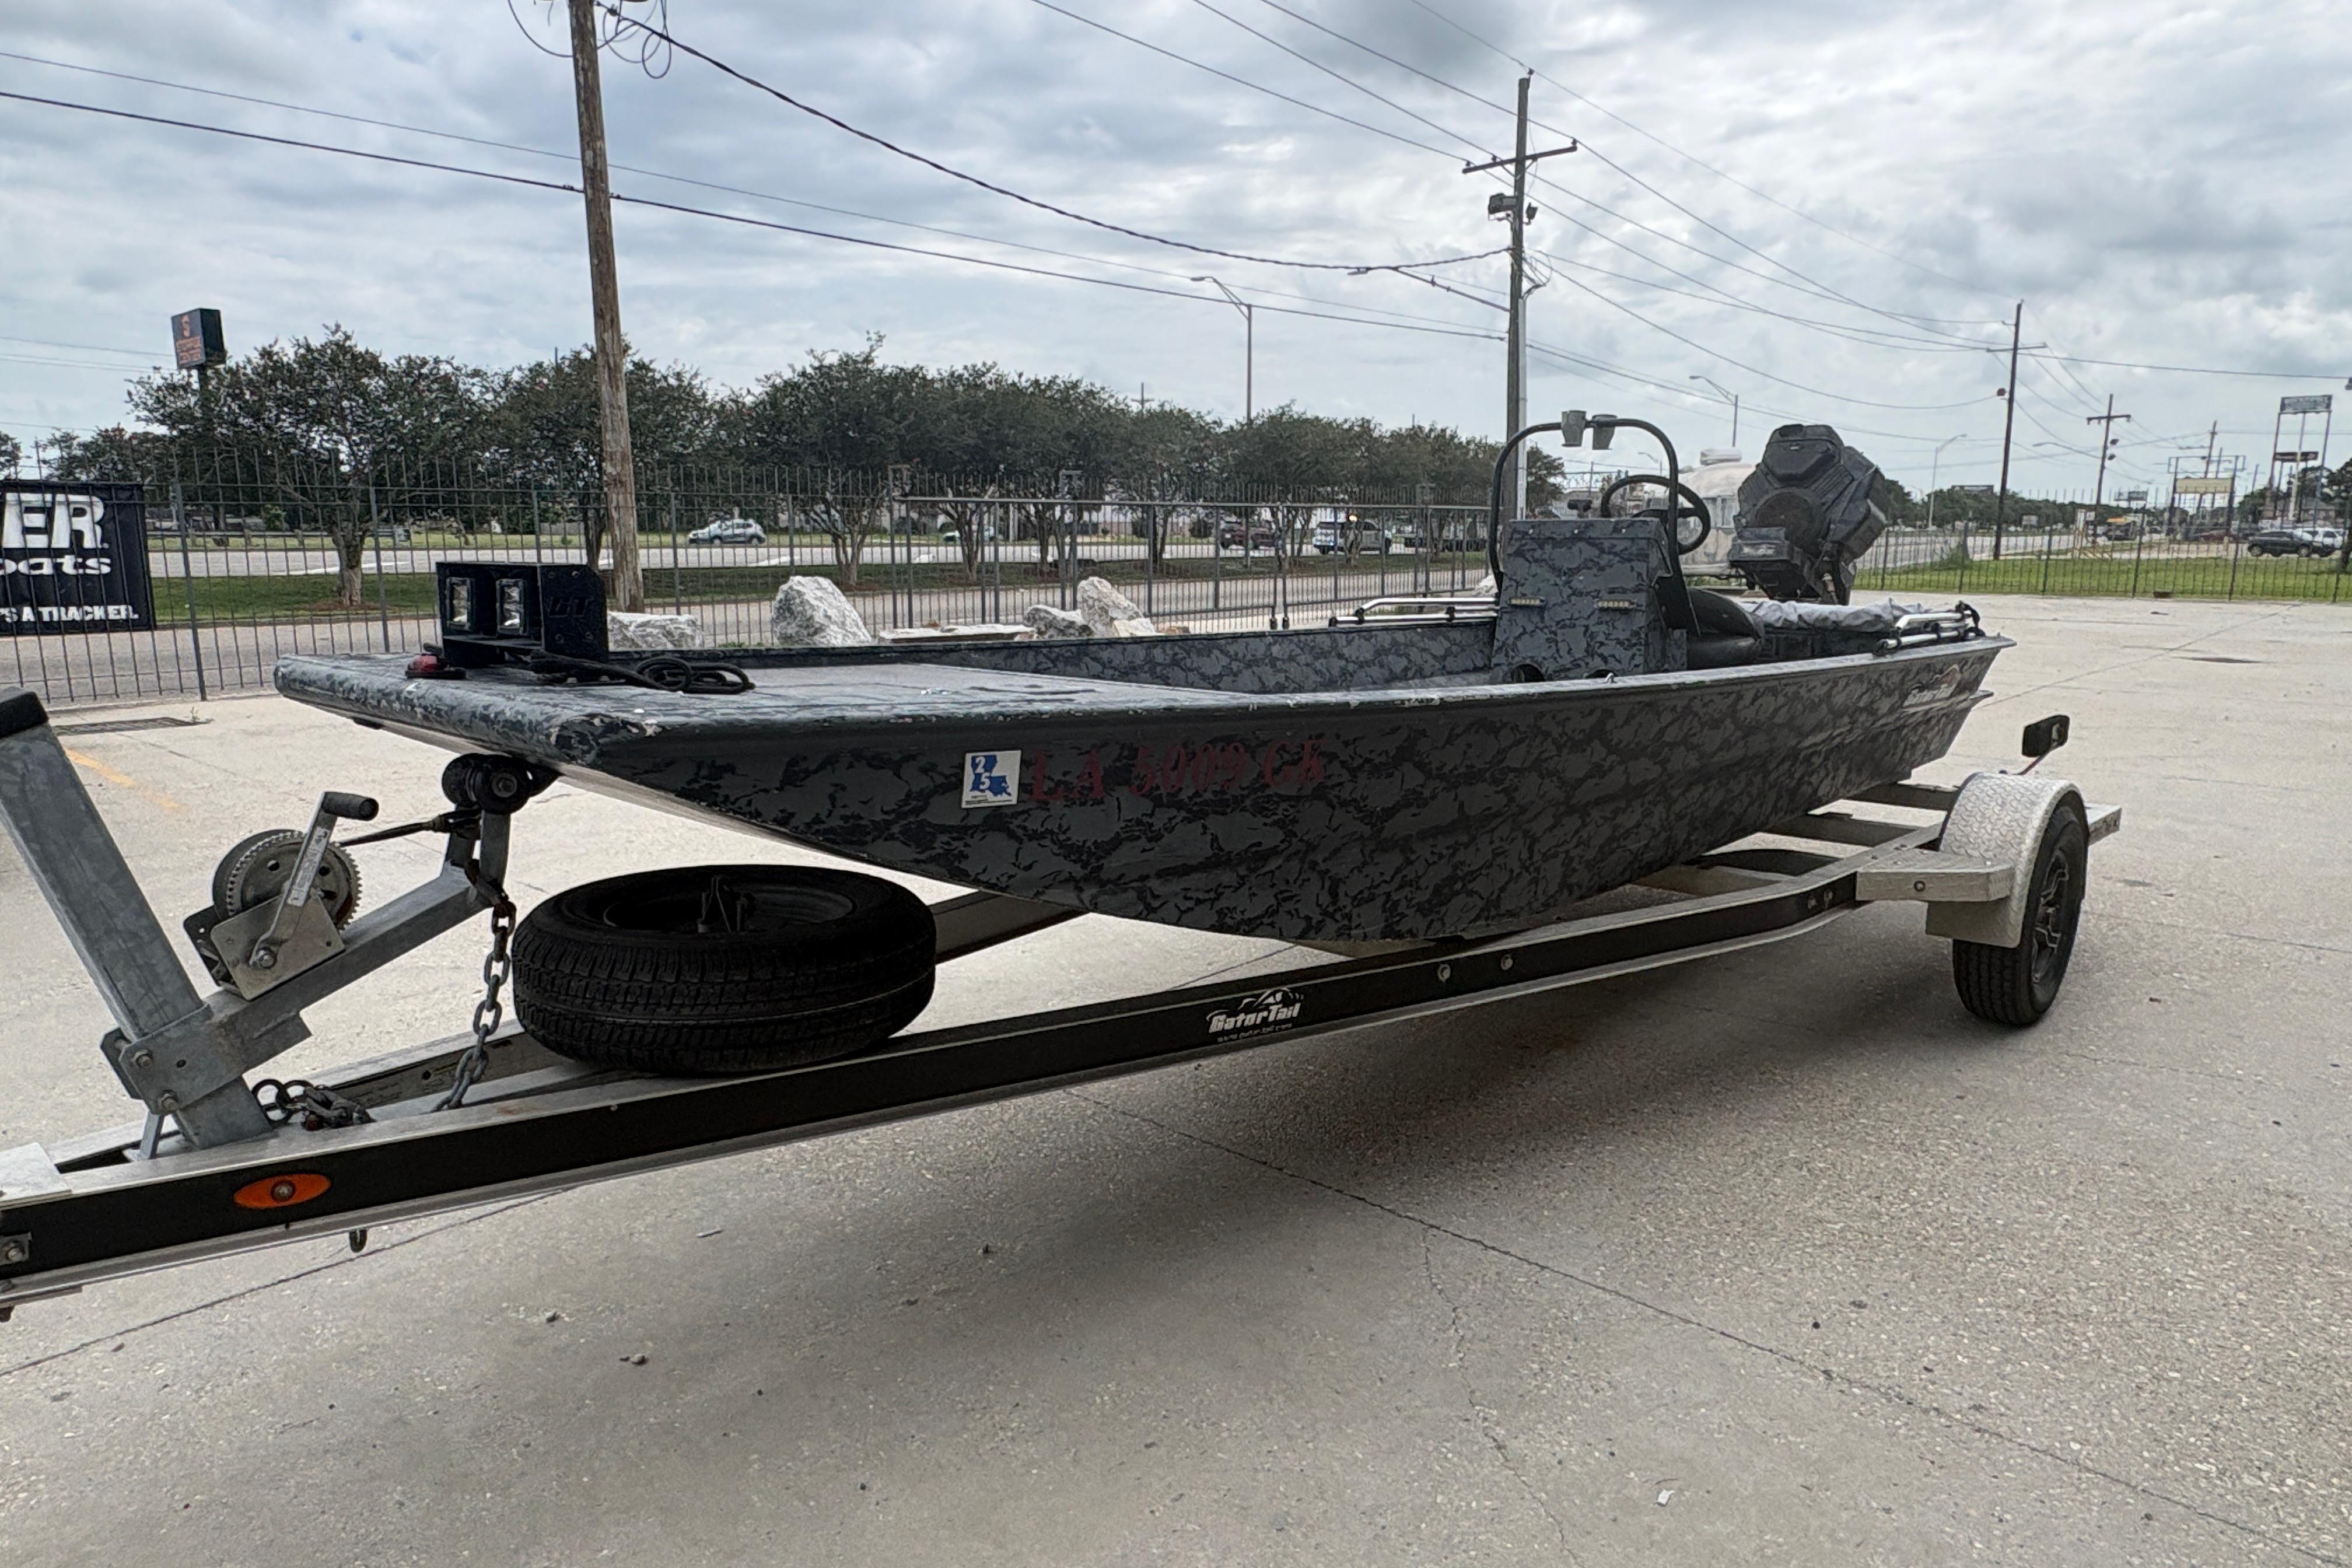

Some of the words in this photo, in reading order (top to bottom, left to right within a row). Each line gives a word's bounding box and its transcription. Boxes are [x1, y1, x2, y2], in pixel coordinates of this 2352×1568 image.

[22, 606, 35, 622] A
[975, 756, 986, 773] 2
[1028, 748, 1105, 802] LA
[1129, 741, 1247, 797] 5009
[979, 773, 991, 789] 5
